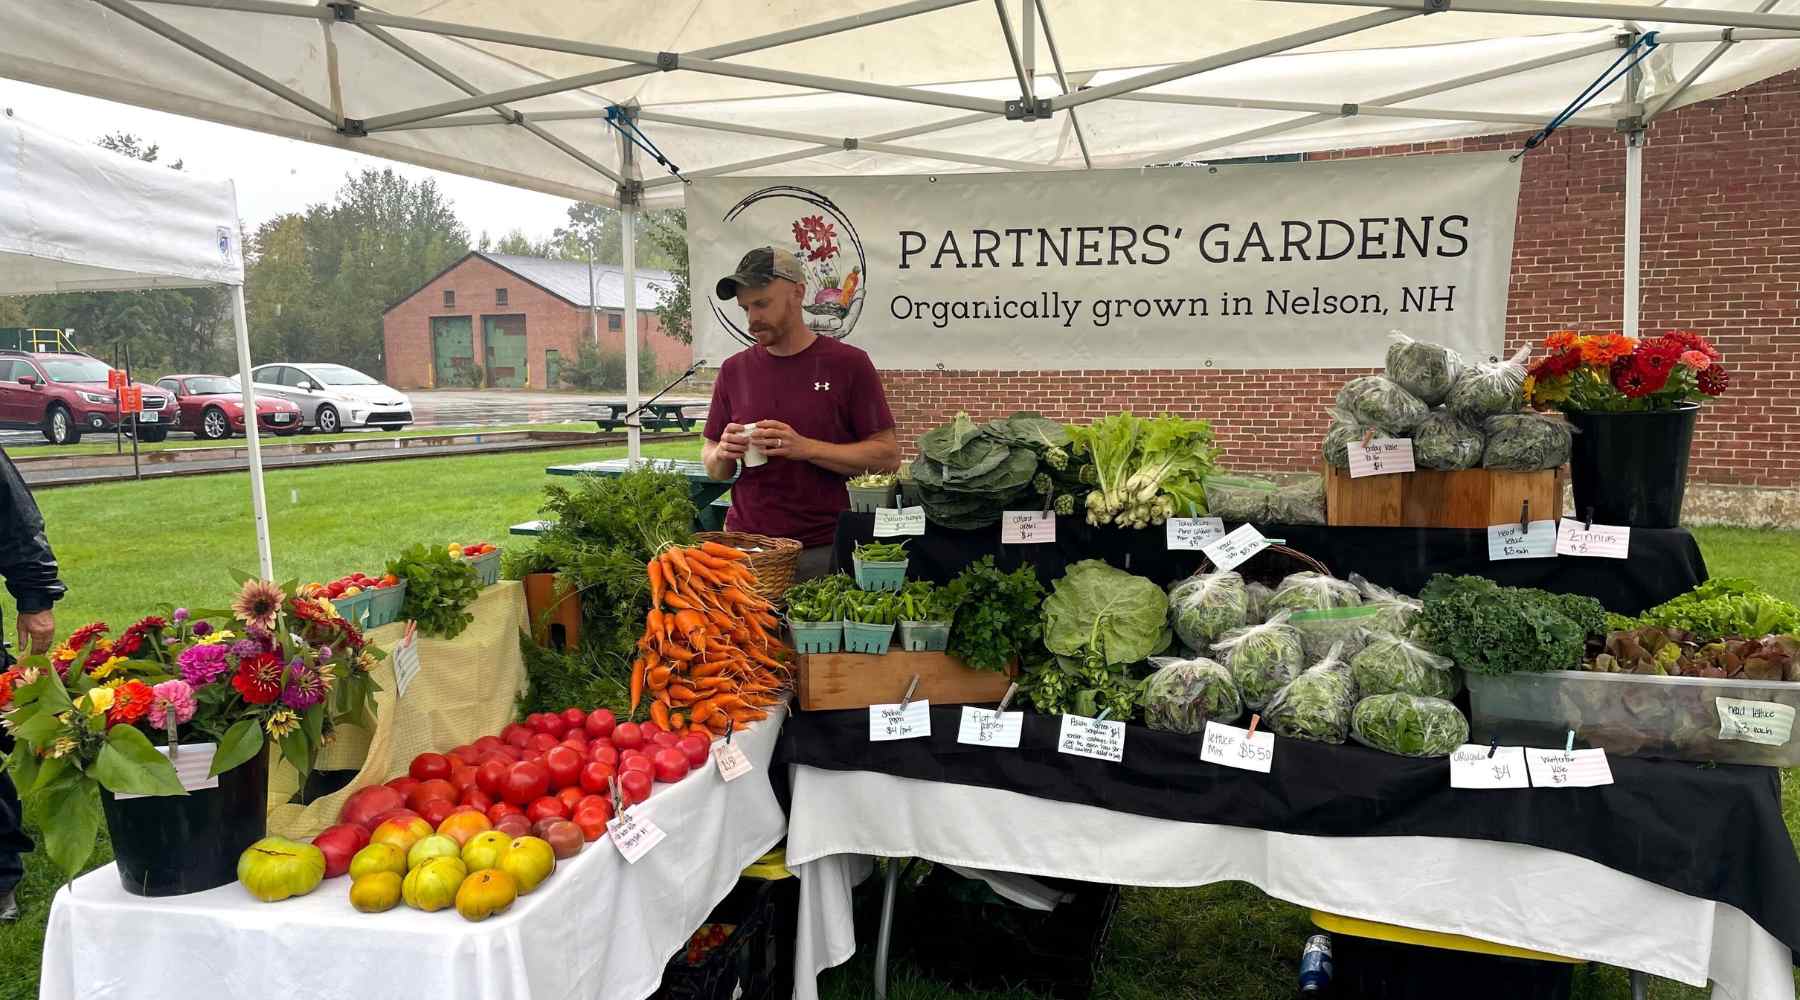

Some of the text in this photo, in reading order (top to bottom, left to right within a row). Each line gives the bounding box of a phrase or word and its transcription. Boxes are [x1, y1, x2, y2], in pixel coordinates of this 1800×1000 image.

[1198, 214, 1470, 265] GARDENS
[889, 285, 1457, 329] Organically grown in Nelson, NH
